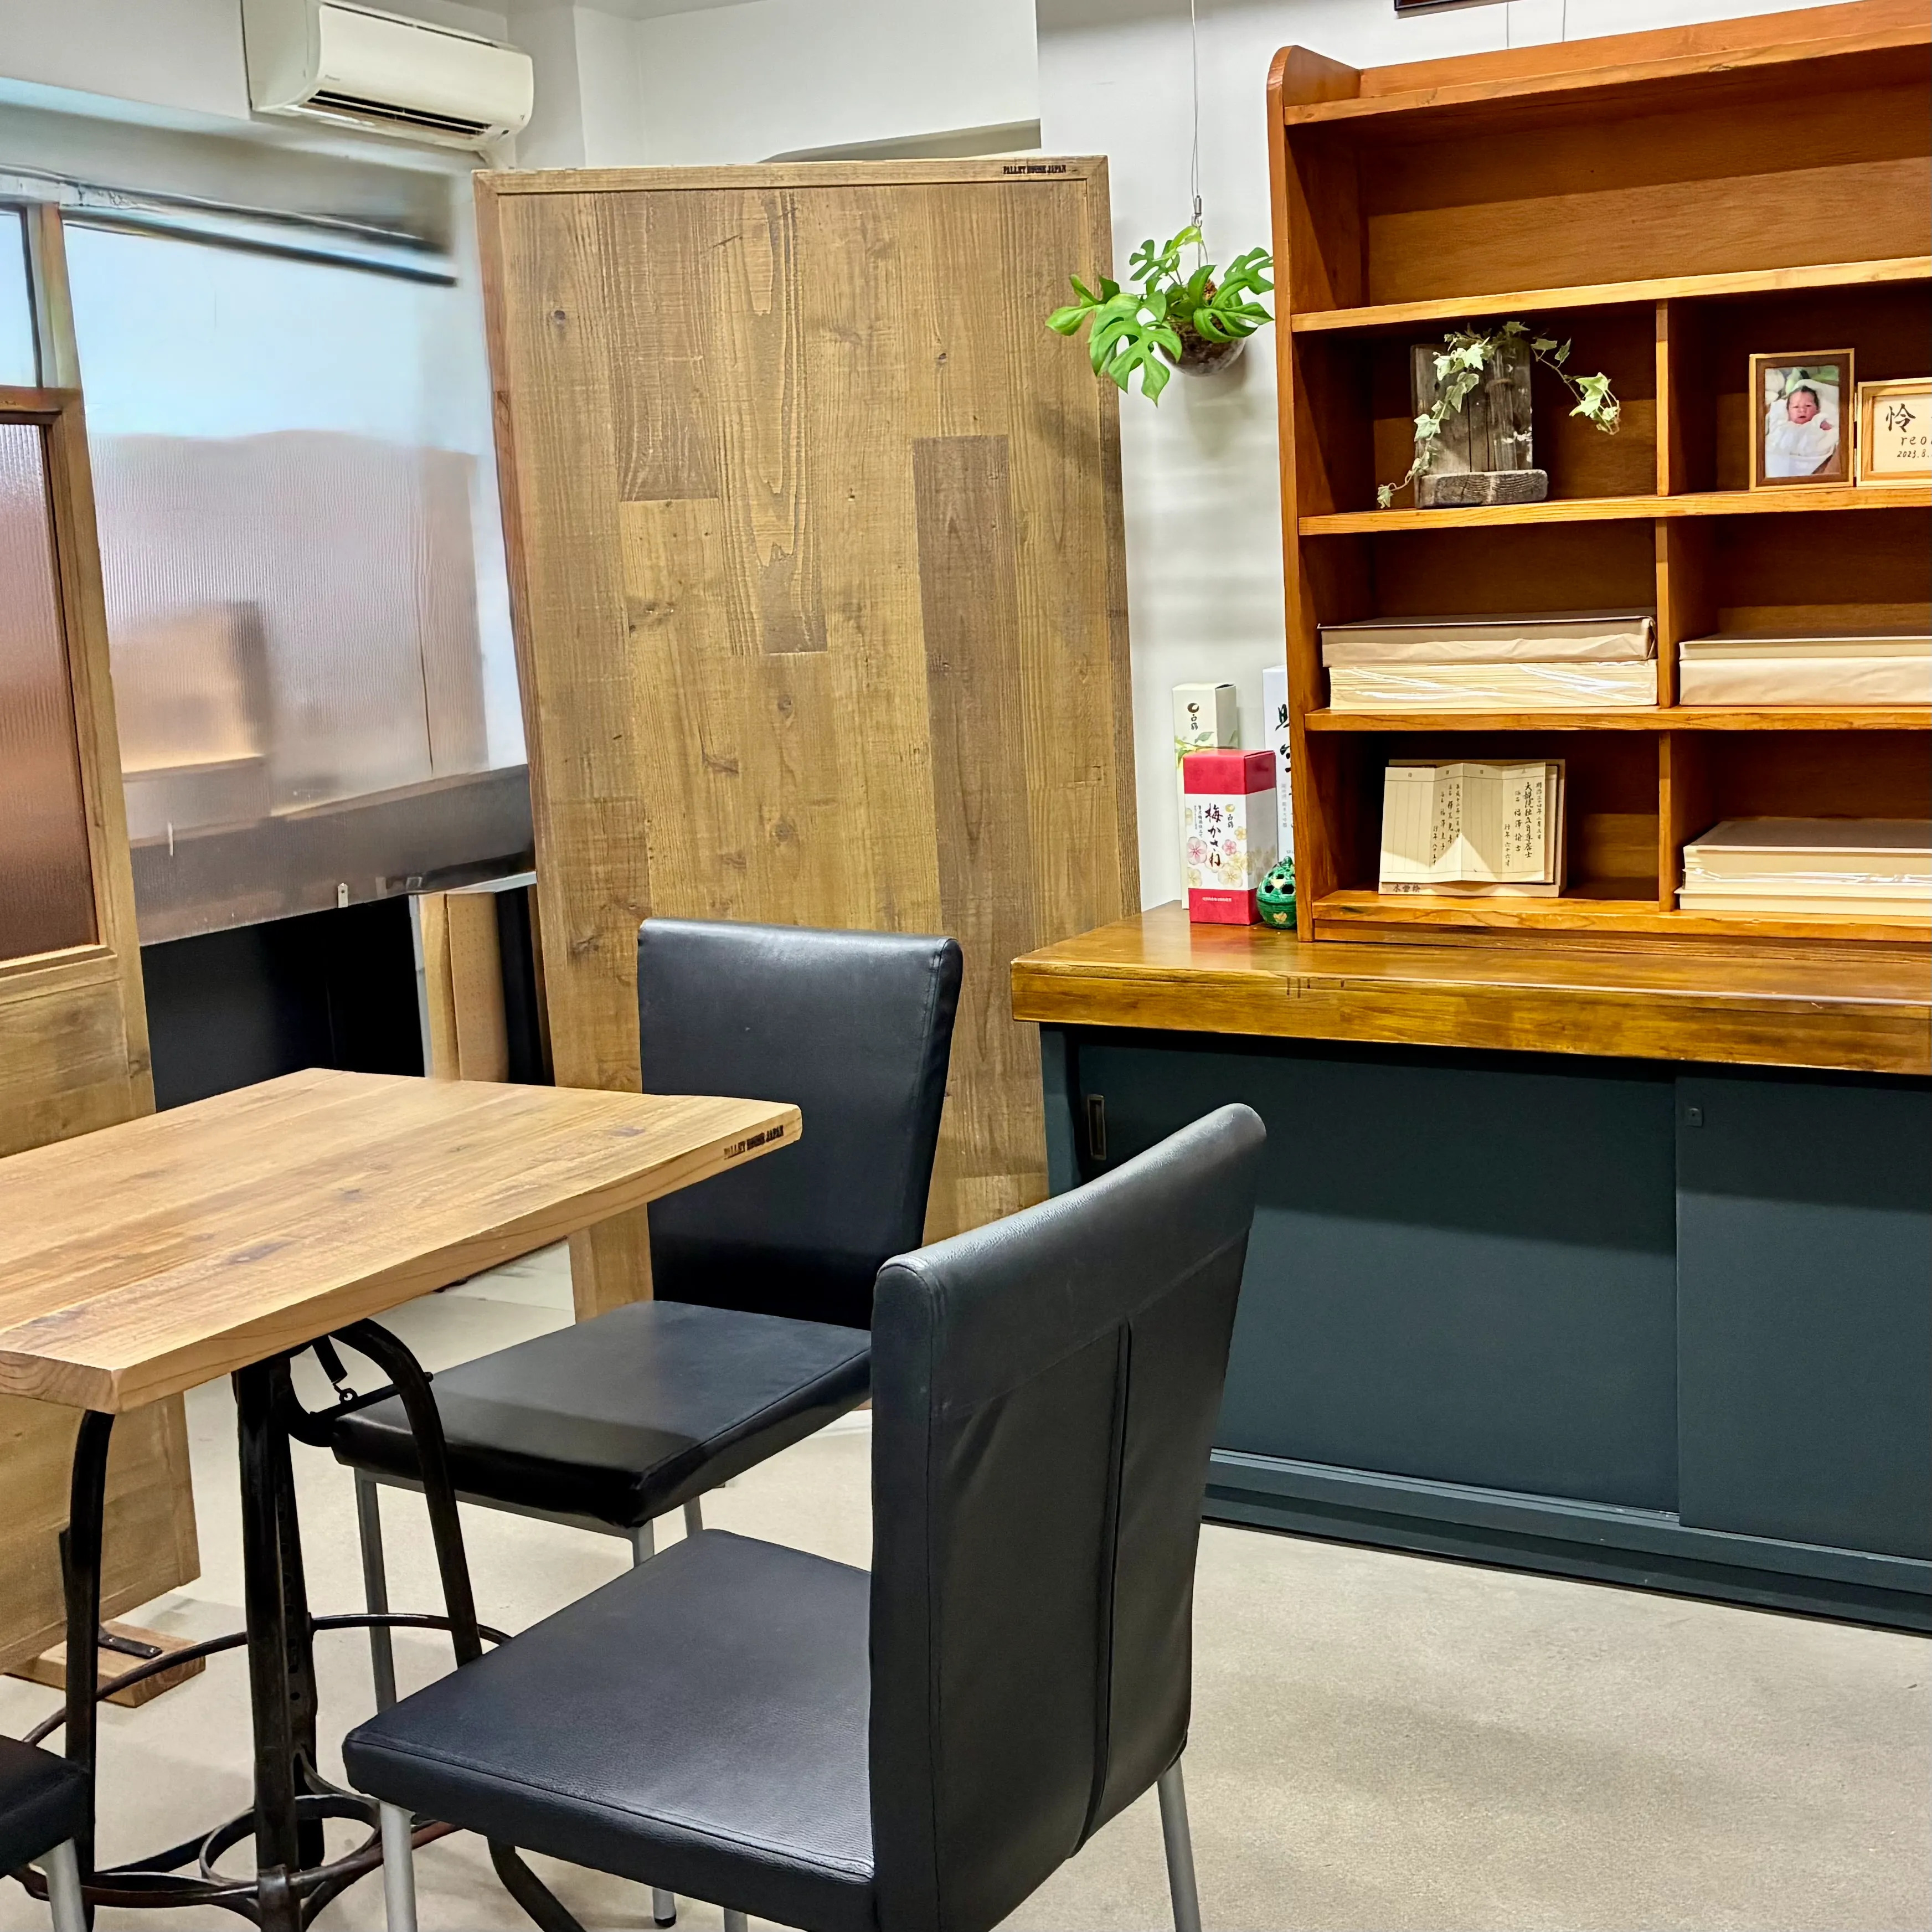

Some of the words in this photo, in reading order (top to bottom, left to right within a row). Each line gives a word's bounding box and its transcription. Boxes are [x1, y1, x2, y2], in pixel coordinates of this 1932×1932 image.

[1047, 164, 1066, 173] JAPAN
[1885, 403, 1932, 432] 怜
[1901, 436, 1932, 446] reo
[1897, 449, 1932, 458] 2023.8.
[1205, 803, 1223, 867] 梅かさね
